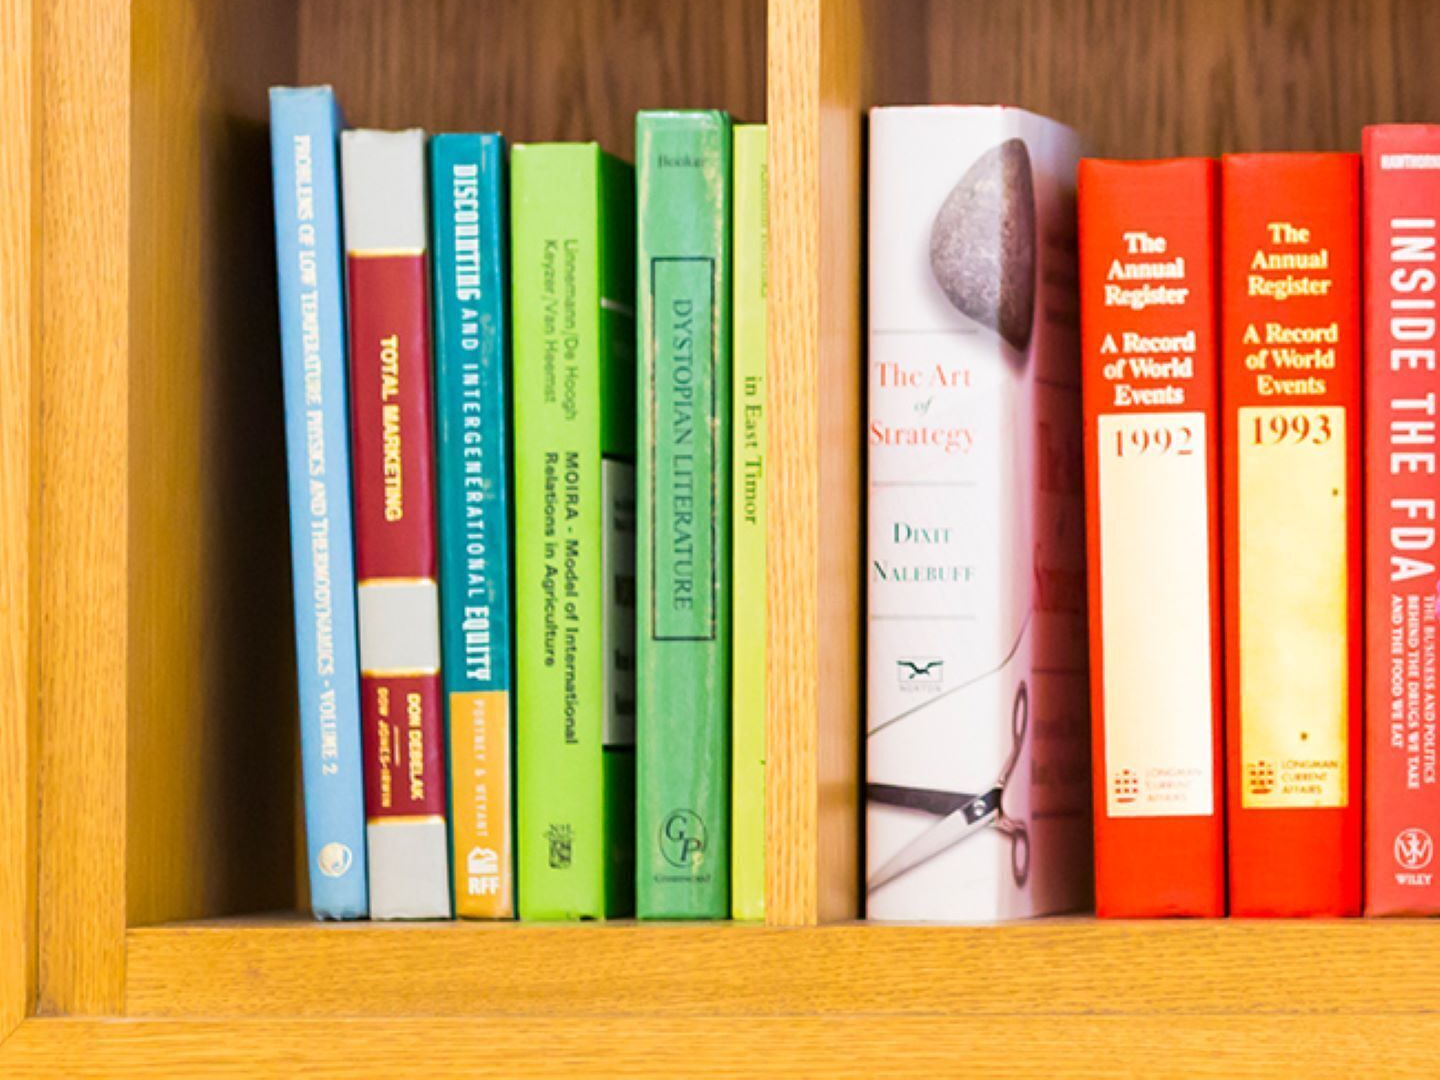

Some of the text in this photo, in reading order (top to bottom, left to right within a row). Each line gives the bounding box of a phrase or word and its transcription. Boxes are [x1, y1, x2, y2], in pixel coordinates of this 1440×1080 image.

[1123, 232, 1166, 254] The
[1267, 223, 1310, 244] The
[1107, 257, 1185, 280] Annual
[1251, 249, 1328, 269] Annual
[1104, 285, 1189, 310] Register
[1248, 275, 1331, 300] Register
[1390, 219, 1436, 370] INSIDE
[1100, 331, 1196, 353] A Record
[544, 339, 557, 402] Heemst
[876, 361, 971, 388] The Art
[1103, 357, 1193, 379] of World
[561, 366, 578, 420] Hoogh
[914, 396, 934, 423] of
[1114, 384, 1184, 406] Events
[380, 335, 403, 522] TOTAL MARKETING
[453, 164, 492, 681] DISCOUNTING AND INTERGENERATIONAL EQUITY
[869, 421, 975, 455] Strategy
[1113, 426, 1193, 457] 1992
[1252, 414, 1332, 444] 1993
[1390, 393, 1436, 474] THE
[293, 135, 338, 775] PROBLEMS OF LOW TEMPERATURE PHYSICS AND THERMODYNAMICS VOLUME 2
[672, 299, 694, 611] DYSTOPIAN LITERATURE
[744, 376, 762, 524] in East Timor
[541, 452, 558, 667] Relations in Agriculture
[1390, 498, 1436, 581] FDA
[564, 452, 579, 744] MOIRA Model of International
[1423, 595, 1436, 783] THE BUSINESS AND POLITICS
[406, 693, 424, 800] DON DEBELAK
[473, 699, 486, 761] PORTNEY
[474, 784, 488, 837] WEYANT
[468, 876, 499, 895] RFF
[1395, 873, 1433, 885] WILEY
